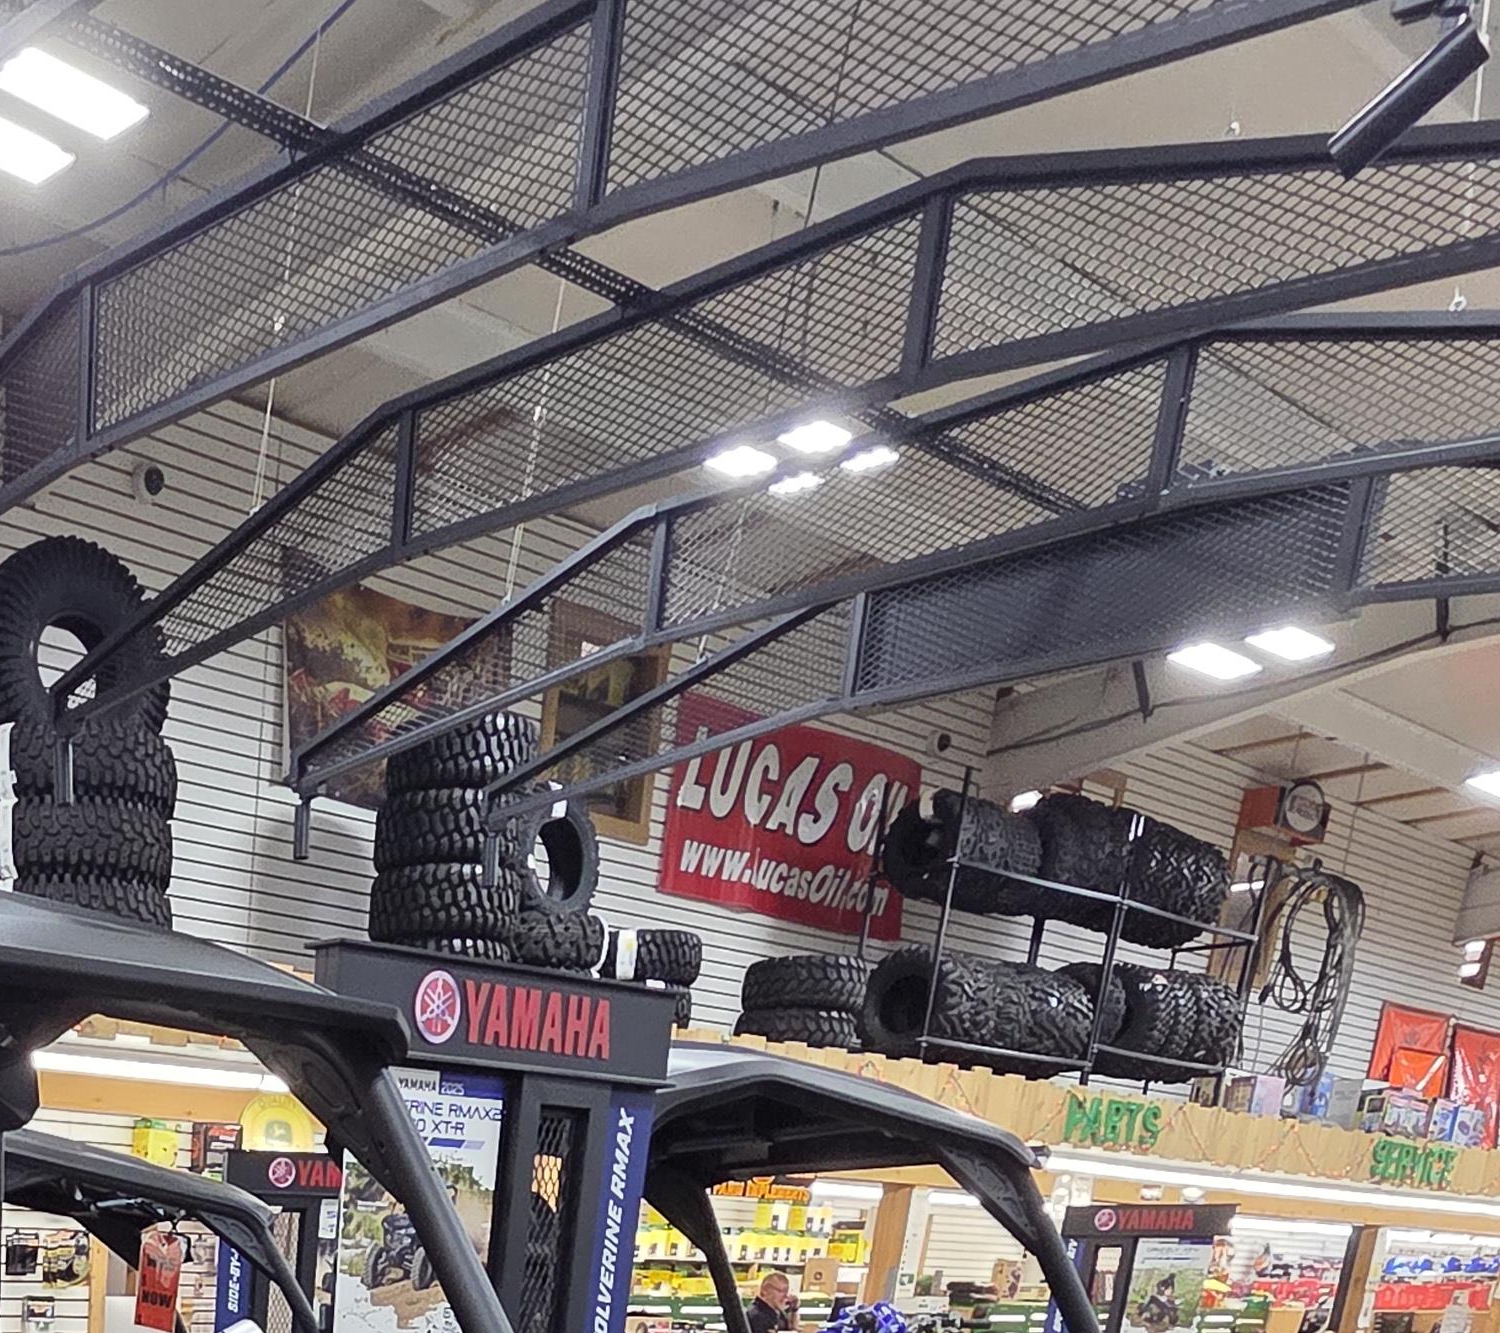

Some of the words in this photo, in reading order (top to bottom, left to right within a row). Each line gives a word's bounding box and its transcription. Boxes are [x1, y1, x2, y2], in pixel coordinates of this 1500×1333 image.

[676, 725, 854, 845] LUCAS
[465, 979, 611, 1060] YAMAHA
[398, 1077, 438, 1092] YAMAHA
[441, 1081, 465, 1096] 2025
[431, 1120, 466, 1136] XT-R
[1063, 1092, 1162, 1148] PARTS
[297, 1159, 342, 1188] YAM
[611, 1106, 635, 1200] RMAX
[1117, 1208, 1195, 1231] YAMAHA
[226, 1248, 242, 1314] SIDE-BY-
